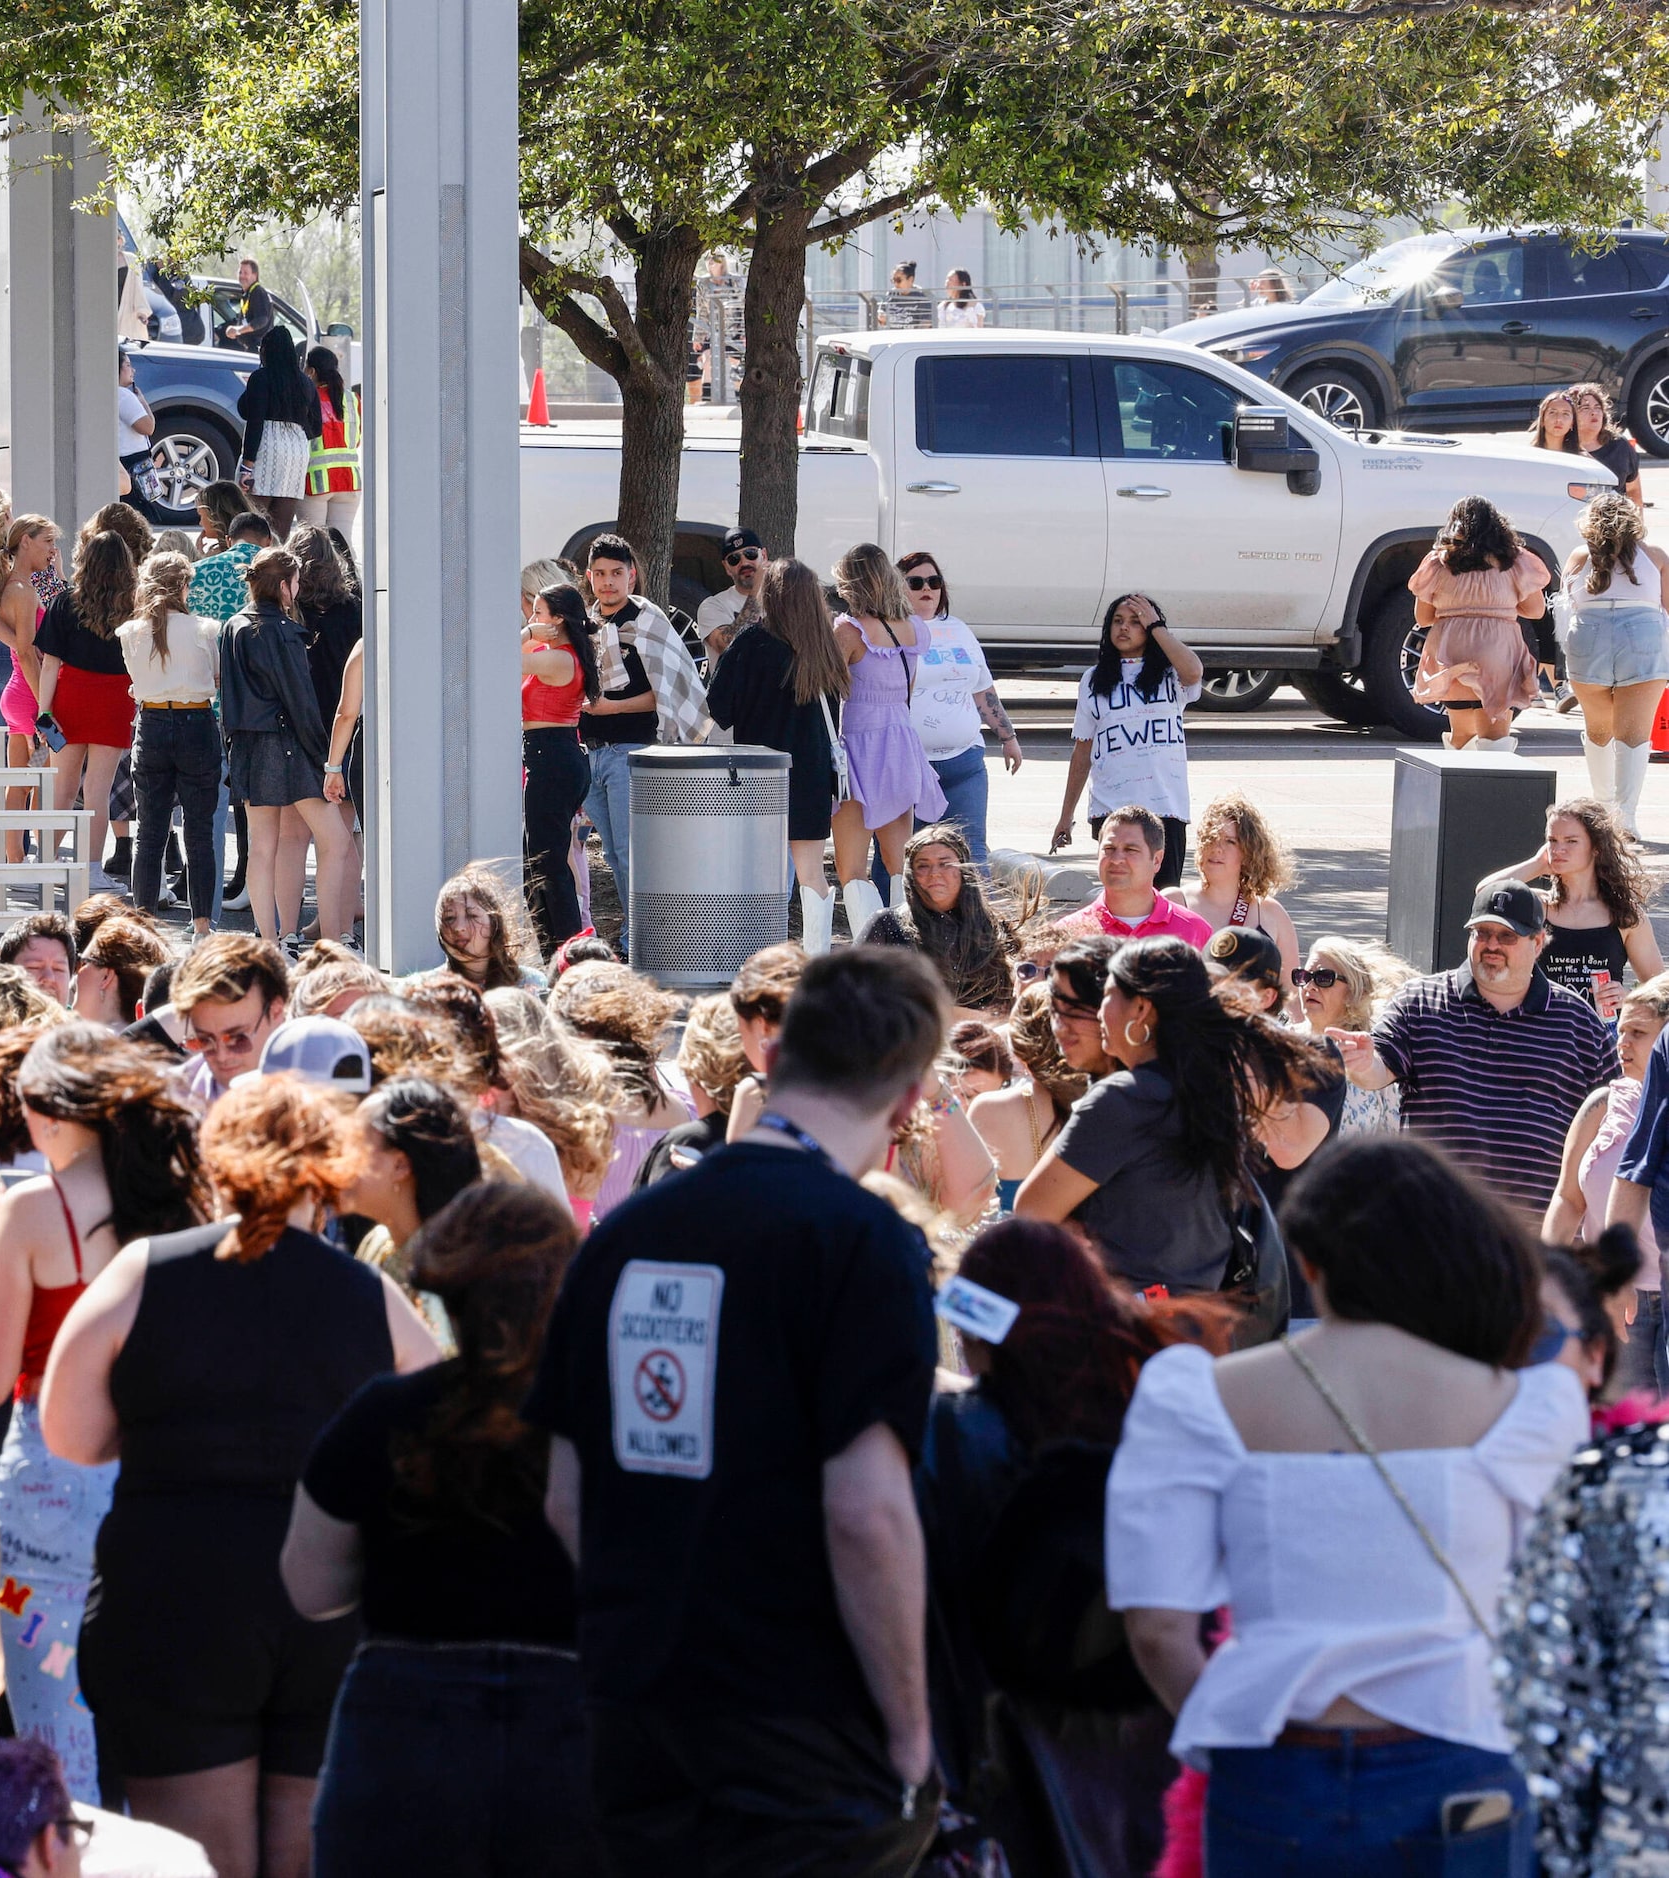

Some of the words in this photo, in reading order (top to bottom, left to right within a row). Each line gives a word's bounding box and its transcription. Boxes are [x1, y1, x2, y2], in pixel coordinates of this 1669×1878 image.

[1094, 715, 1184, 760] JEWELS
[650, 1281, 683, 1312] NO
[628, 1429, 699, 1460] ALLOWED
